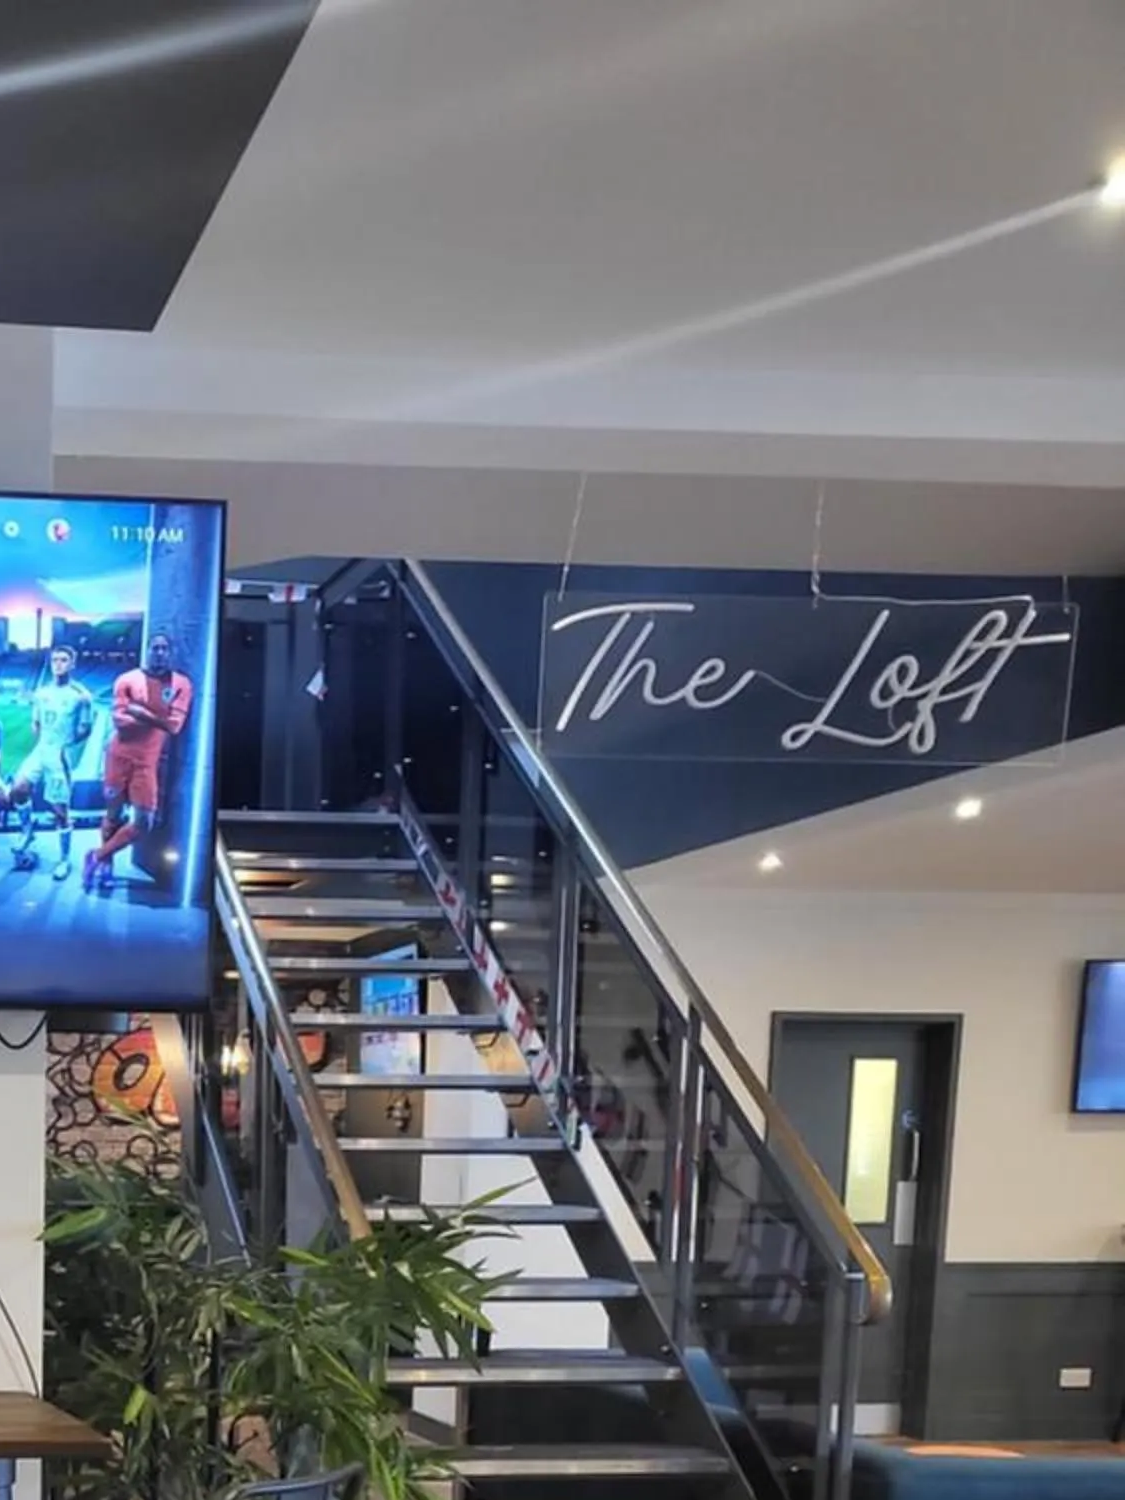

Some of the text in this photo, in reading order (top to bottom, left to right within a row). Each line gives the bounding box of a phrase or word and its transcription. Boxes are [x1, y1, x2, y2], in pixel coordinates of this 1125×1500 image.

[111, 525, 184, 543] 11:10 AM
[551, 602, 1071, 754] The Loft
